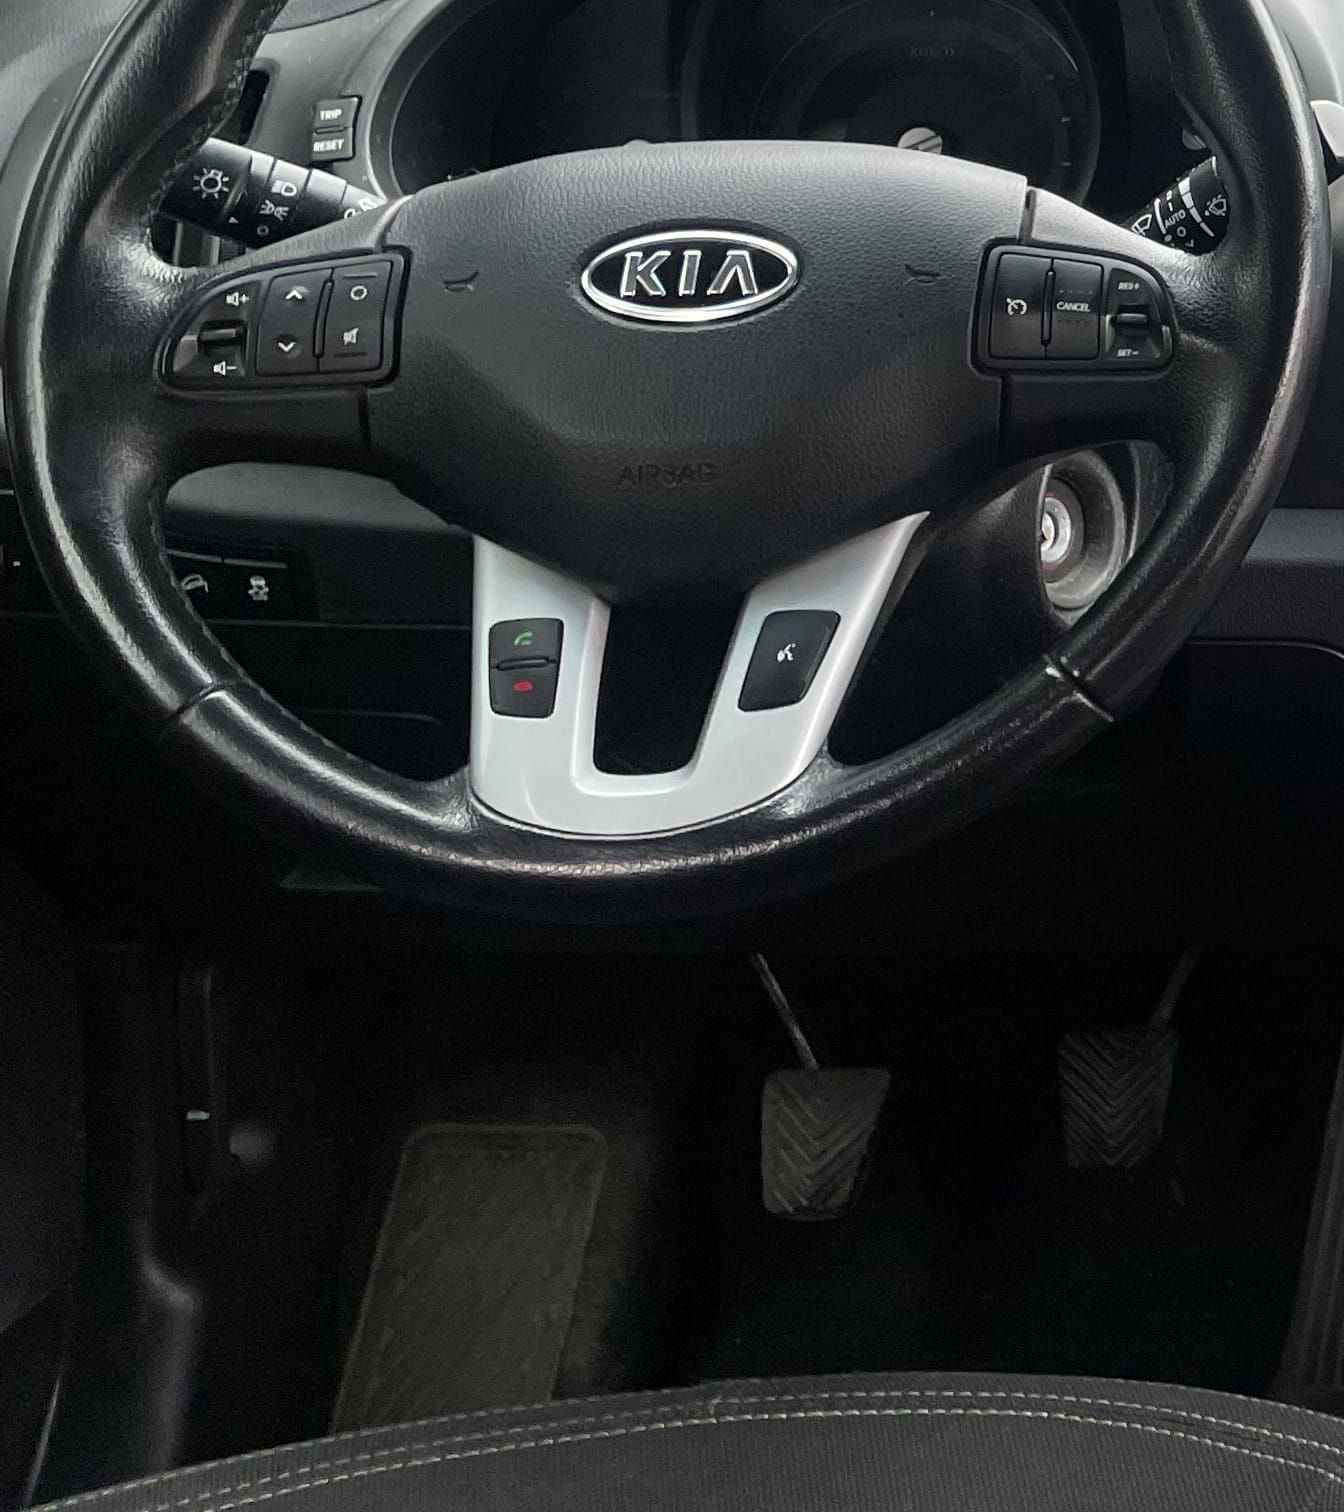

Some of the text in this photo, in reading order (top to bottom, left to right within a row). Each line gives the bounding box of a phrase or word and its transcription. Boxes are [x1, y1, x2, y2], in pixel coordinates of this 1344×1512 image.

[319, 108, 342, 120] TRIP
[313, 139, 345, 152] RESET
[1164, 209, 1187, 229] AUTO
[619, 249, 759, 298] KIA
[1056, 301, 1091, 313] CANCEL
